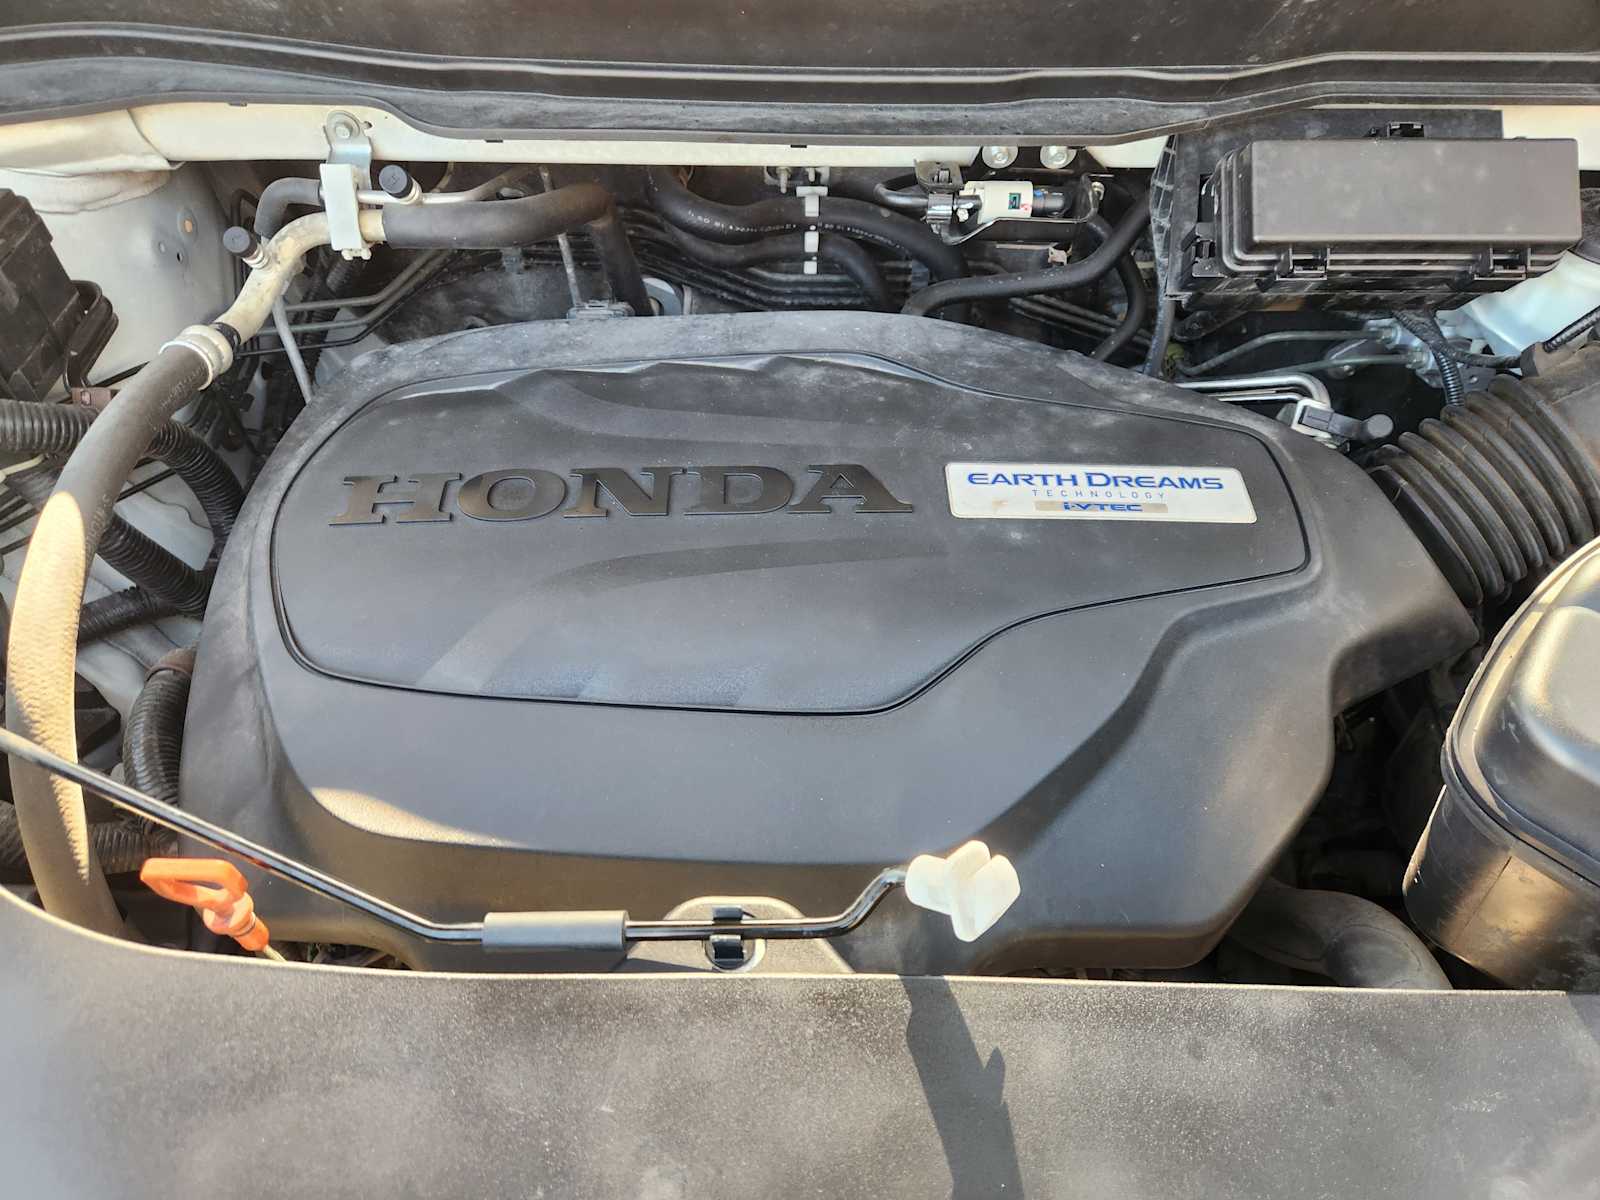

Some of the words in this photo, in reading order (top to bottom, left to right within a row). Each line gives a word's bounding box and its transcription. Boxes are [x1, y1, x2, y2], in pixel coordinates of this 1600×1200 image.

[967, 472, 1078, 487] EARTH
[1084, 472, 1224, 490] DREAMS
[328, 464, 914, 526] HONDA
[1032, 489, 1166, 500] TECHNOLOGY
